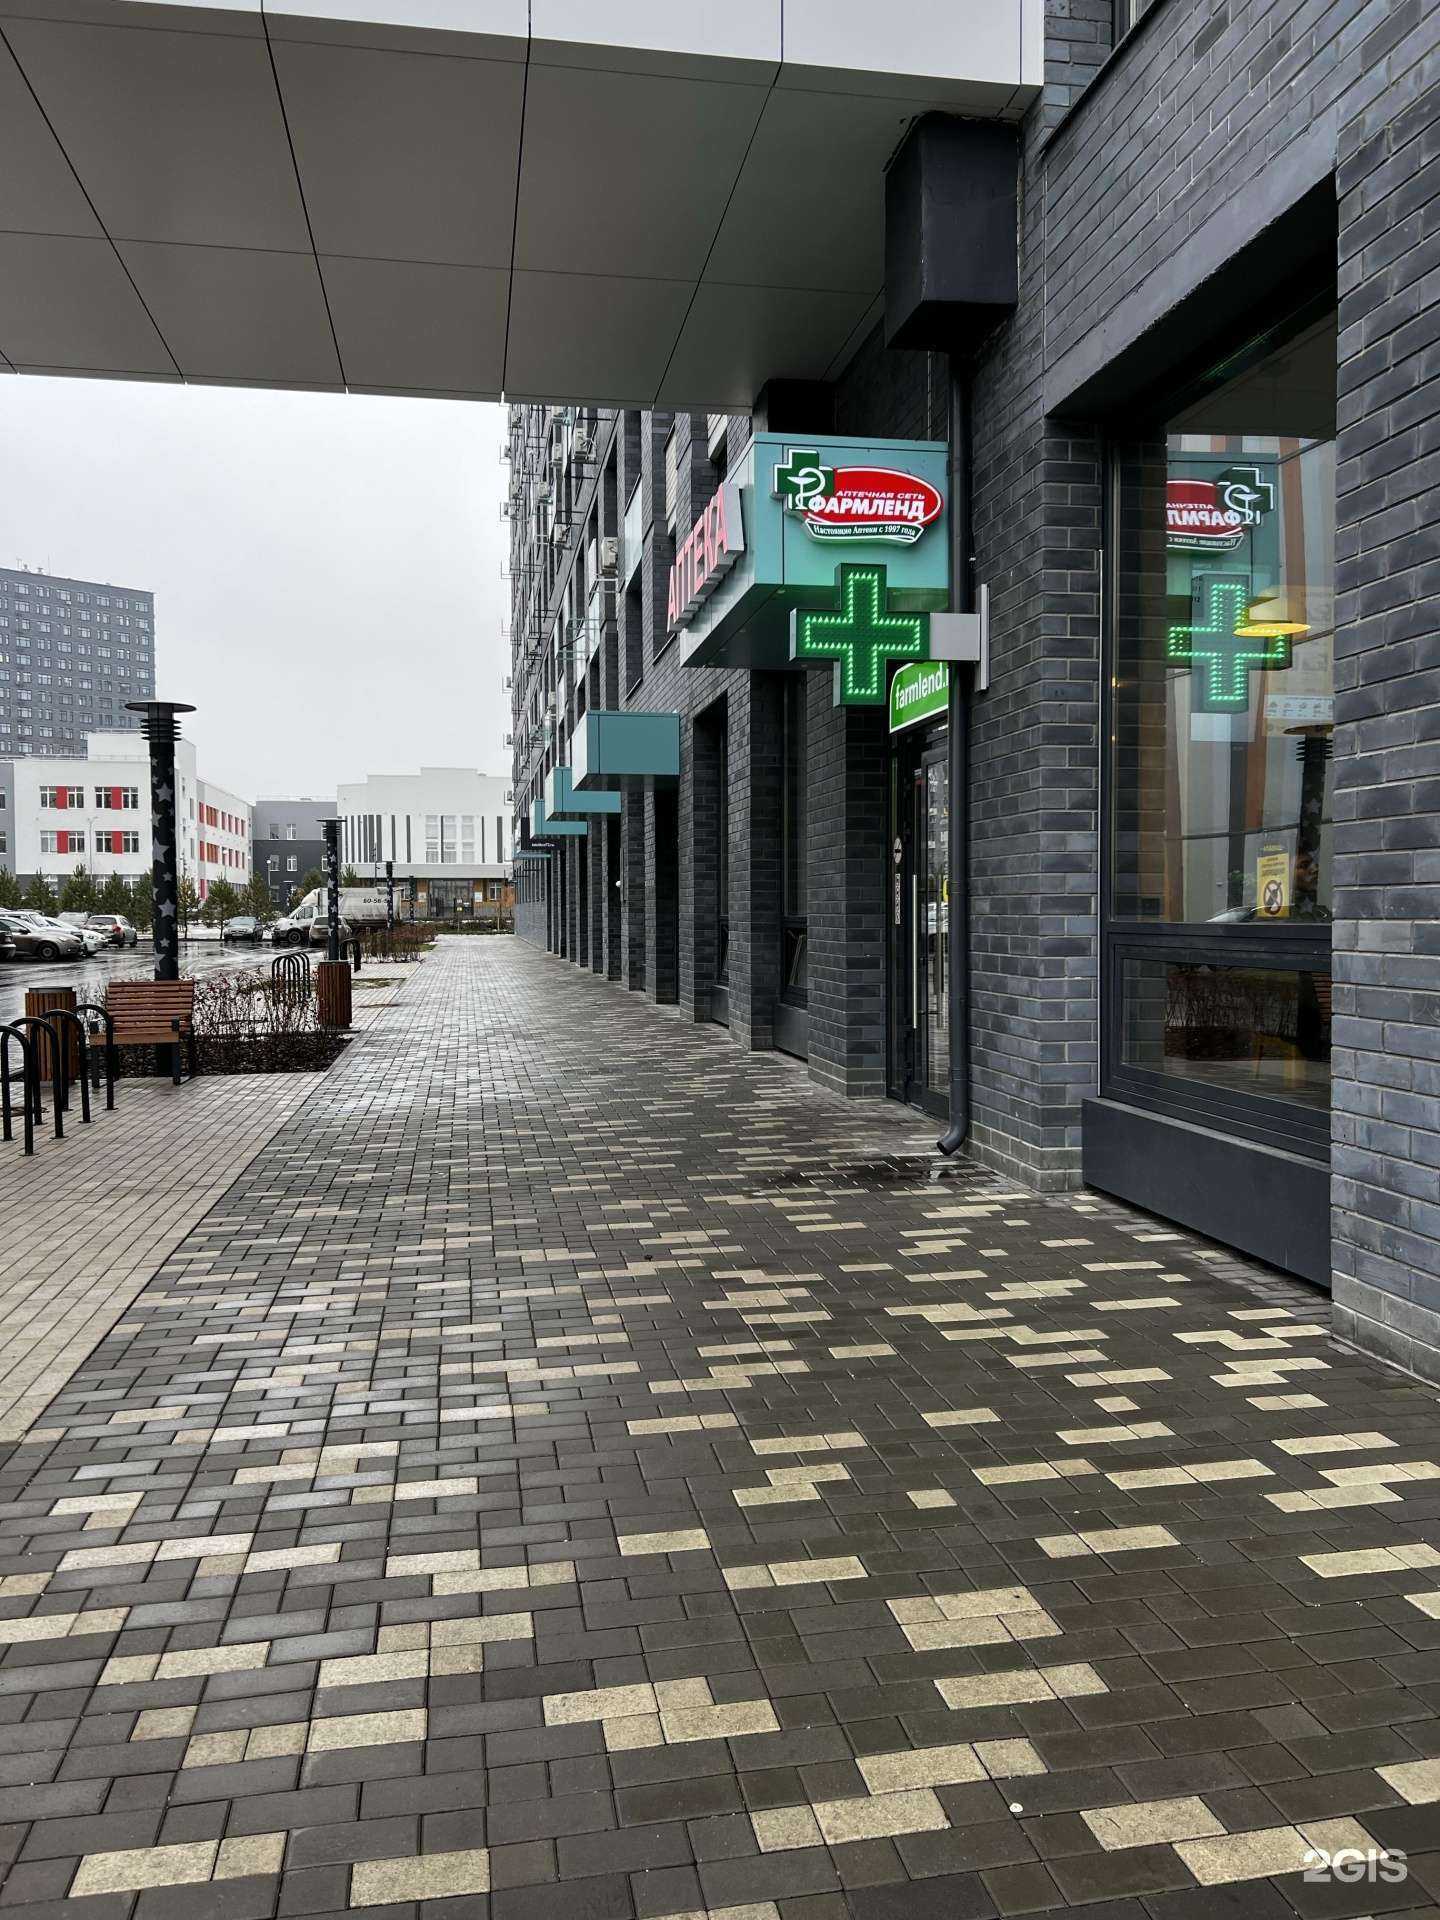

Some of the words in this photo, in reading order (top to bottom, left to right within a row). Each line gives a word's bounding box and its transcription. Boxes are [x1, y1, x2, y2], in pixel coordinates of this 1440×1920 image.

[836, 490, 894, 498] АПТЕЧНАЯ
[897, 492, 925, 500] СЕТЬ
[808, 495, 925, 520] ФАРМЛЕНД
[853, 525, 878, 534] Аптеки
[884, 525, 900, 533] 1997
[901, 527, 916, 536] года
[667, 482, 729, 633] АПТЕКА
